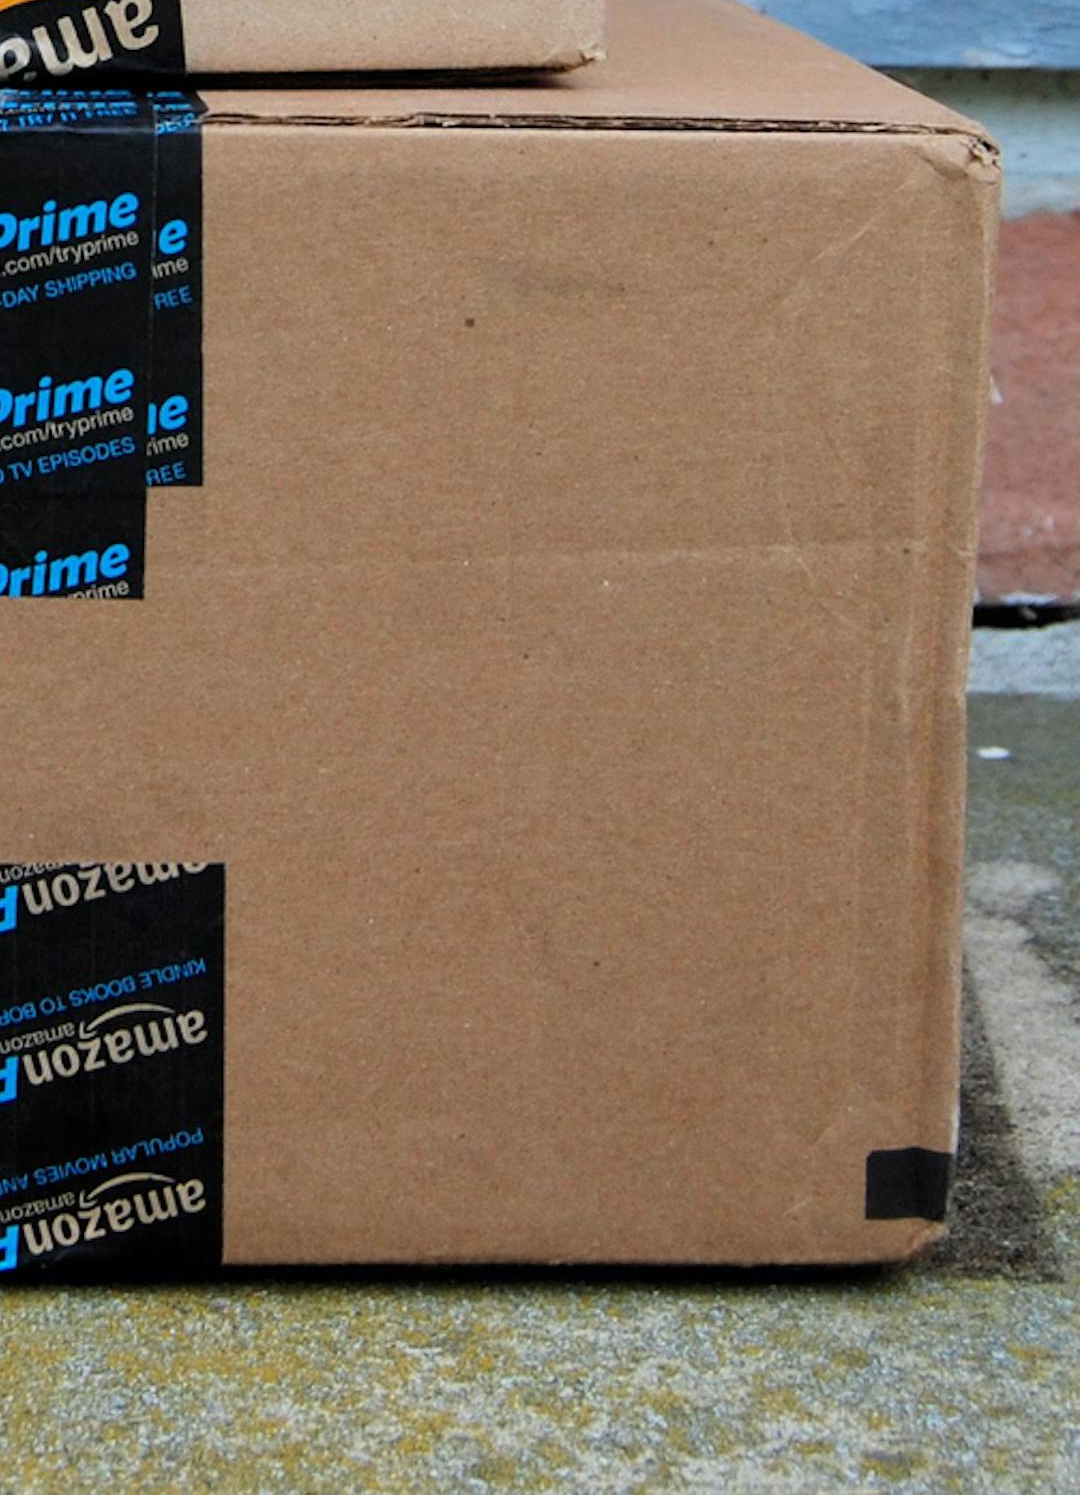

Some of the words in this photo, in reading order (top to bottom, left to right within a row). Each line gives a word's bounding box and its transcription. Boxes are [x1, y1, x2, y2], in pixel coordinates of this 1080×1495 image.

[44, 261, 137, 298] SHIPPING
[153, 286, 193, 309] REE
[8, 460, 32, 480] TV
[38, 436, 136, 474] EPISODES
[146, 461, 187, 486] REE
[139, 957, 207, 989] KINDLE
[39, 994, 67, 1014] TO
[69, 975, 137, 1007] BOOKS
[112, 1127, 205, 1166] POPULAR
[33, 1153, 108, 1186] MOVIES
